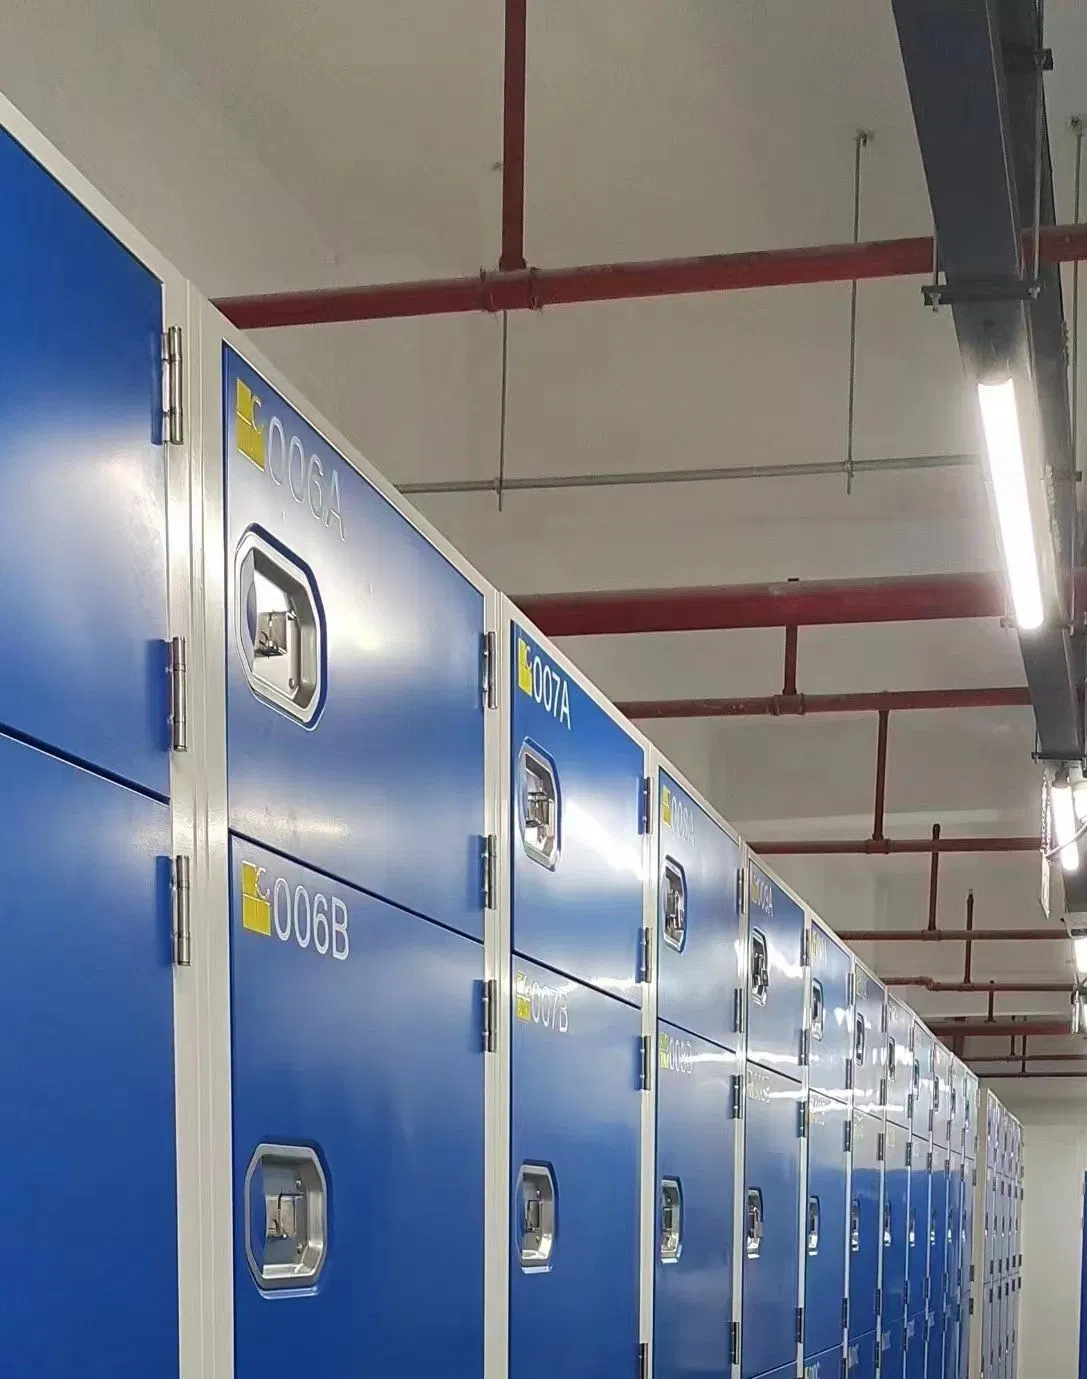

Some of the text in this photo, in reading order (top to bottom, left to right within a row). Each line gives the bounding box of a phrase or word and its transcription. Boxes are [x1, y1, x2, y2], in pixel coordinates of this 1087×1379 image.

[268, 415, 346, 543] 006A
[533, 655, 571, 731] 007A
[273, 877, 350, 961] 006B
[531, 982, 568, 1033] 007B
